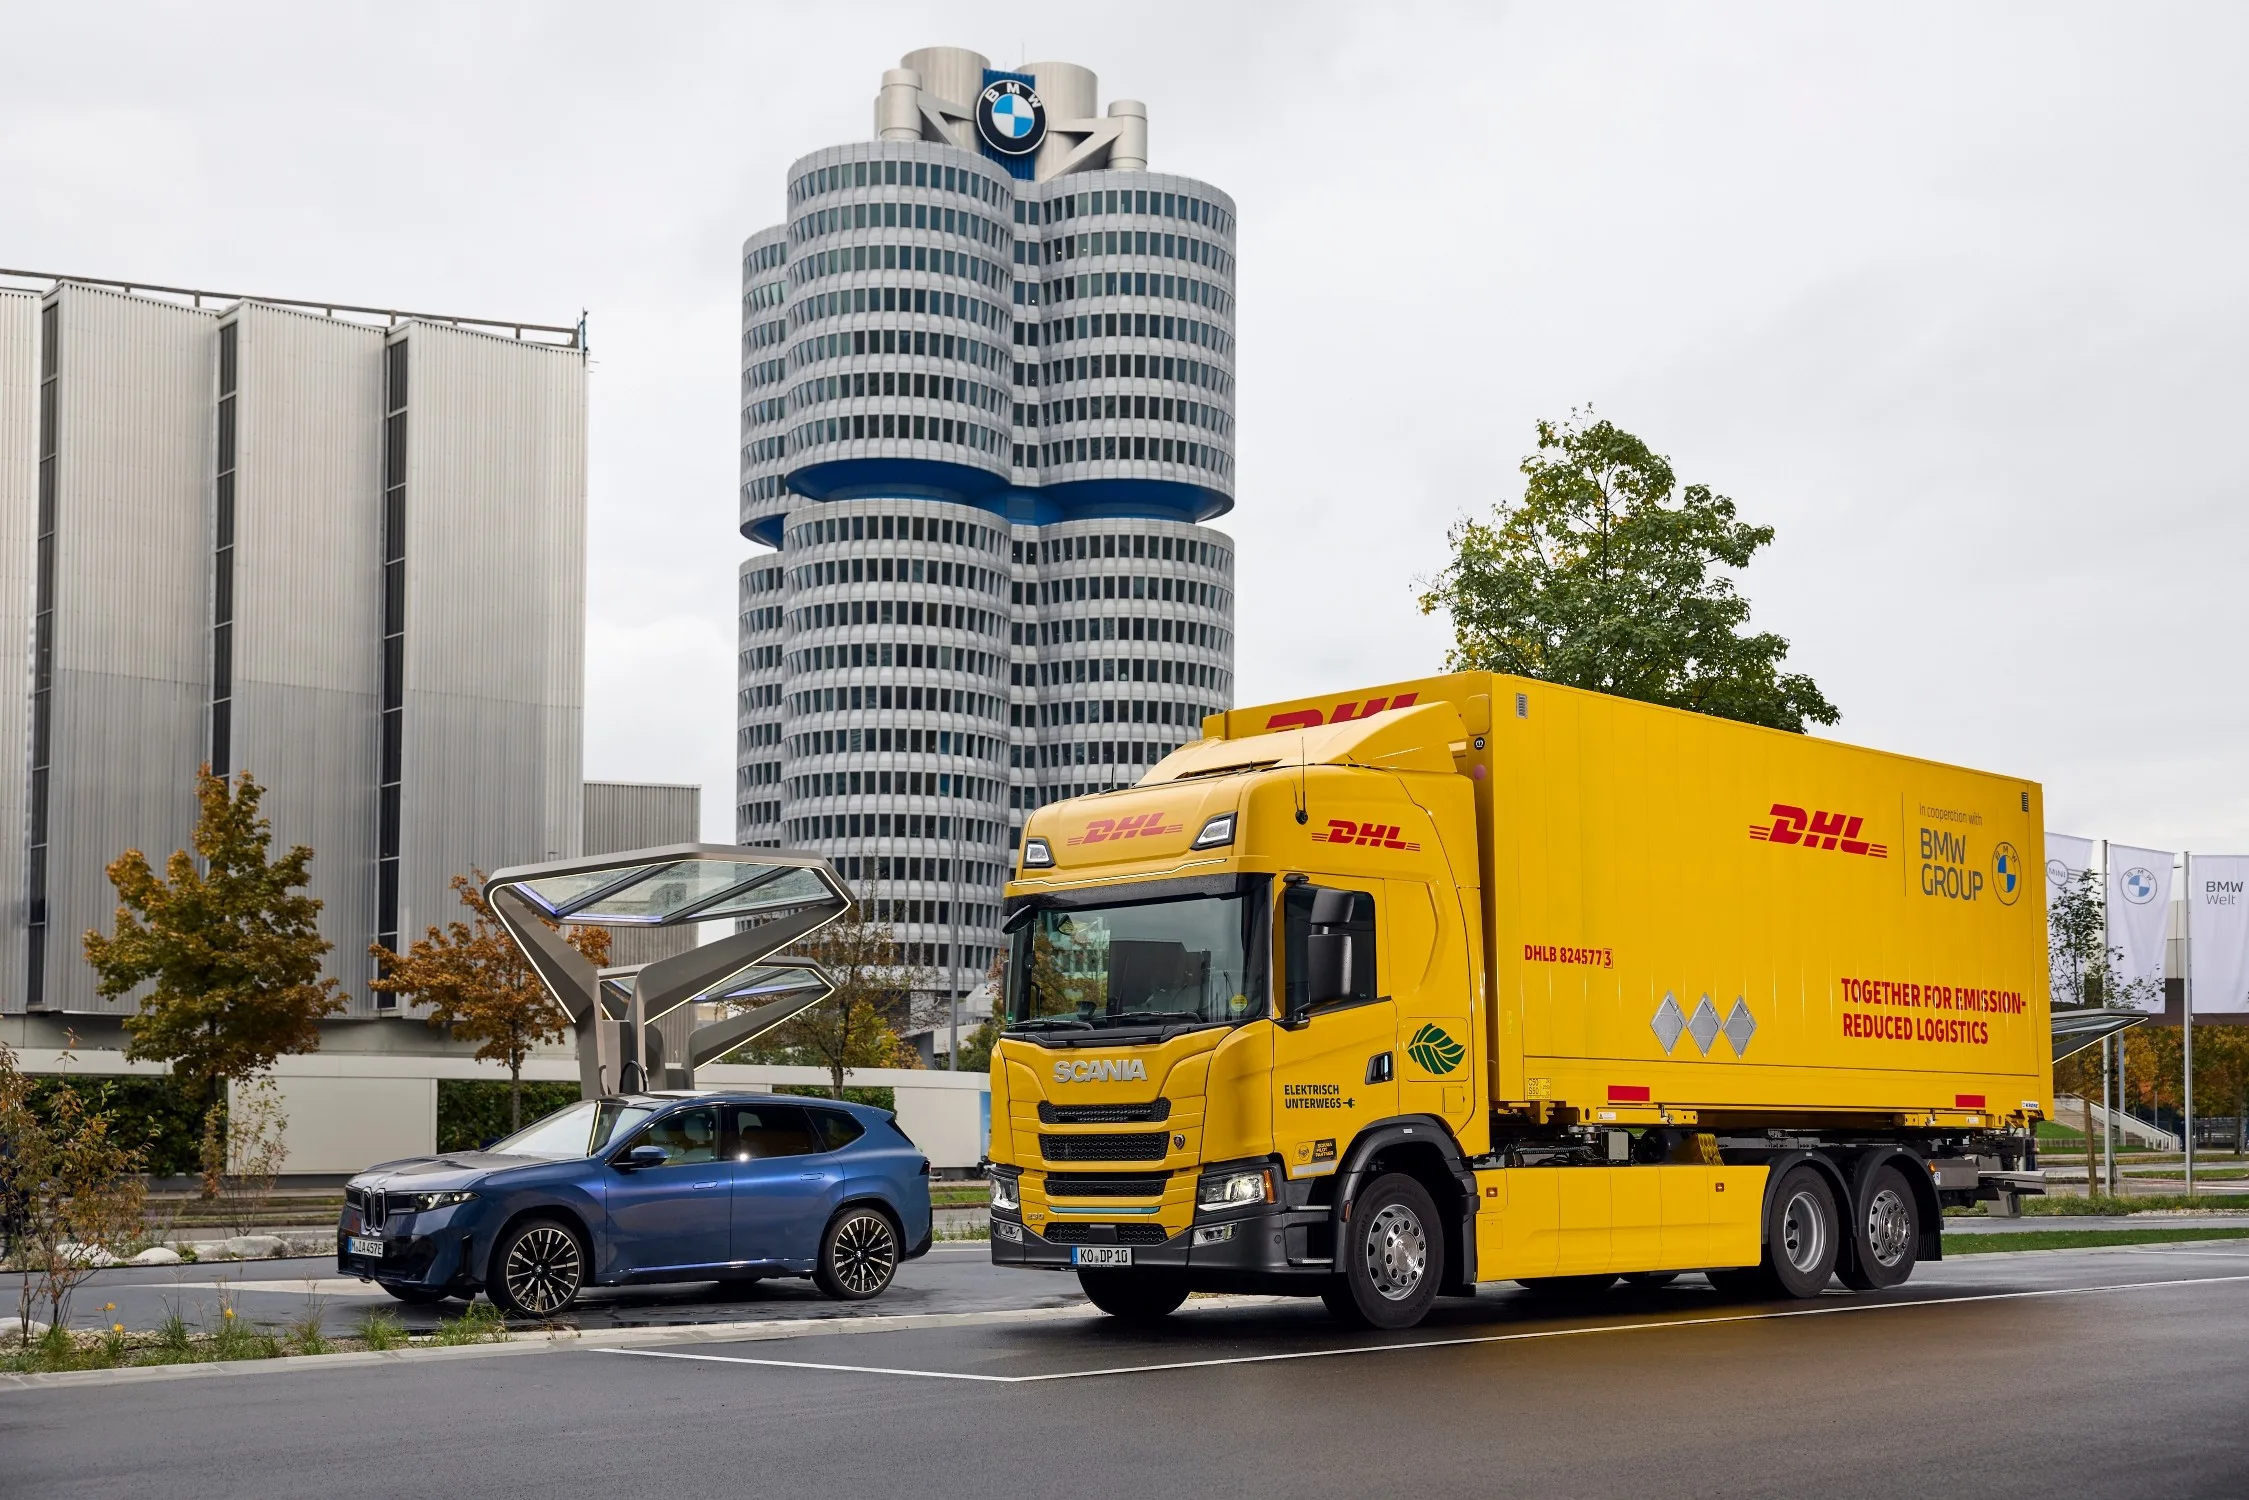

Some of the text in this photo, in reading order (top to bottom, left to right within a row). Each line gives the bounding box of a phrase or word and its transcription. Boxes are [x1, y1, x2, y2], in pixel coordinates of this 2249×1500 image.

[985, 82, 1042, 108] BMW
[1919, 802, 1983, 826] In cooperation with
[1081, 812, 1168, 845] DHL
[1328, 819, 1407, 850] DHL
[1769, 803, 1871, 856] DHL
[1920, 827, 1966, 864] BMW
[1995, 845, 2018, 863] BMW
[1921, 863, 1984, 901] GROUP
[2048, 866, 2066, 879] MINI
[2127, 869, 2154, 882] BMW
[2205, 881, 2244, 892] BMW
[2206, 893, 2236, 905] Welt
[1524, 944, 1557, 962] DHLB
[1841, 977, 2027, 1014] TOGETHER FOR EMISSION-
[1843, 1013, 1989, 1045] REDUCED LOGISTICS
[1053, 1059, 1148, 1083] SCANIA
[1284, 1084, 1340, 1095] ELEKTRISCH
[1285, 1098, 1342, 1109] UNTERWEGS
[367, 1242, 383, 1255] 457E
[1080, 1248, 1128, 1263] KO DP 10
